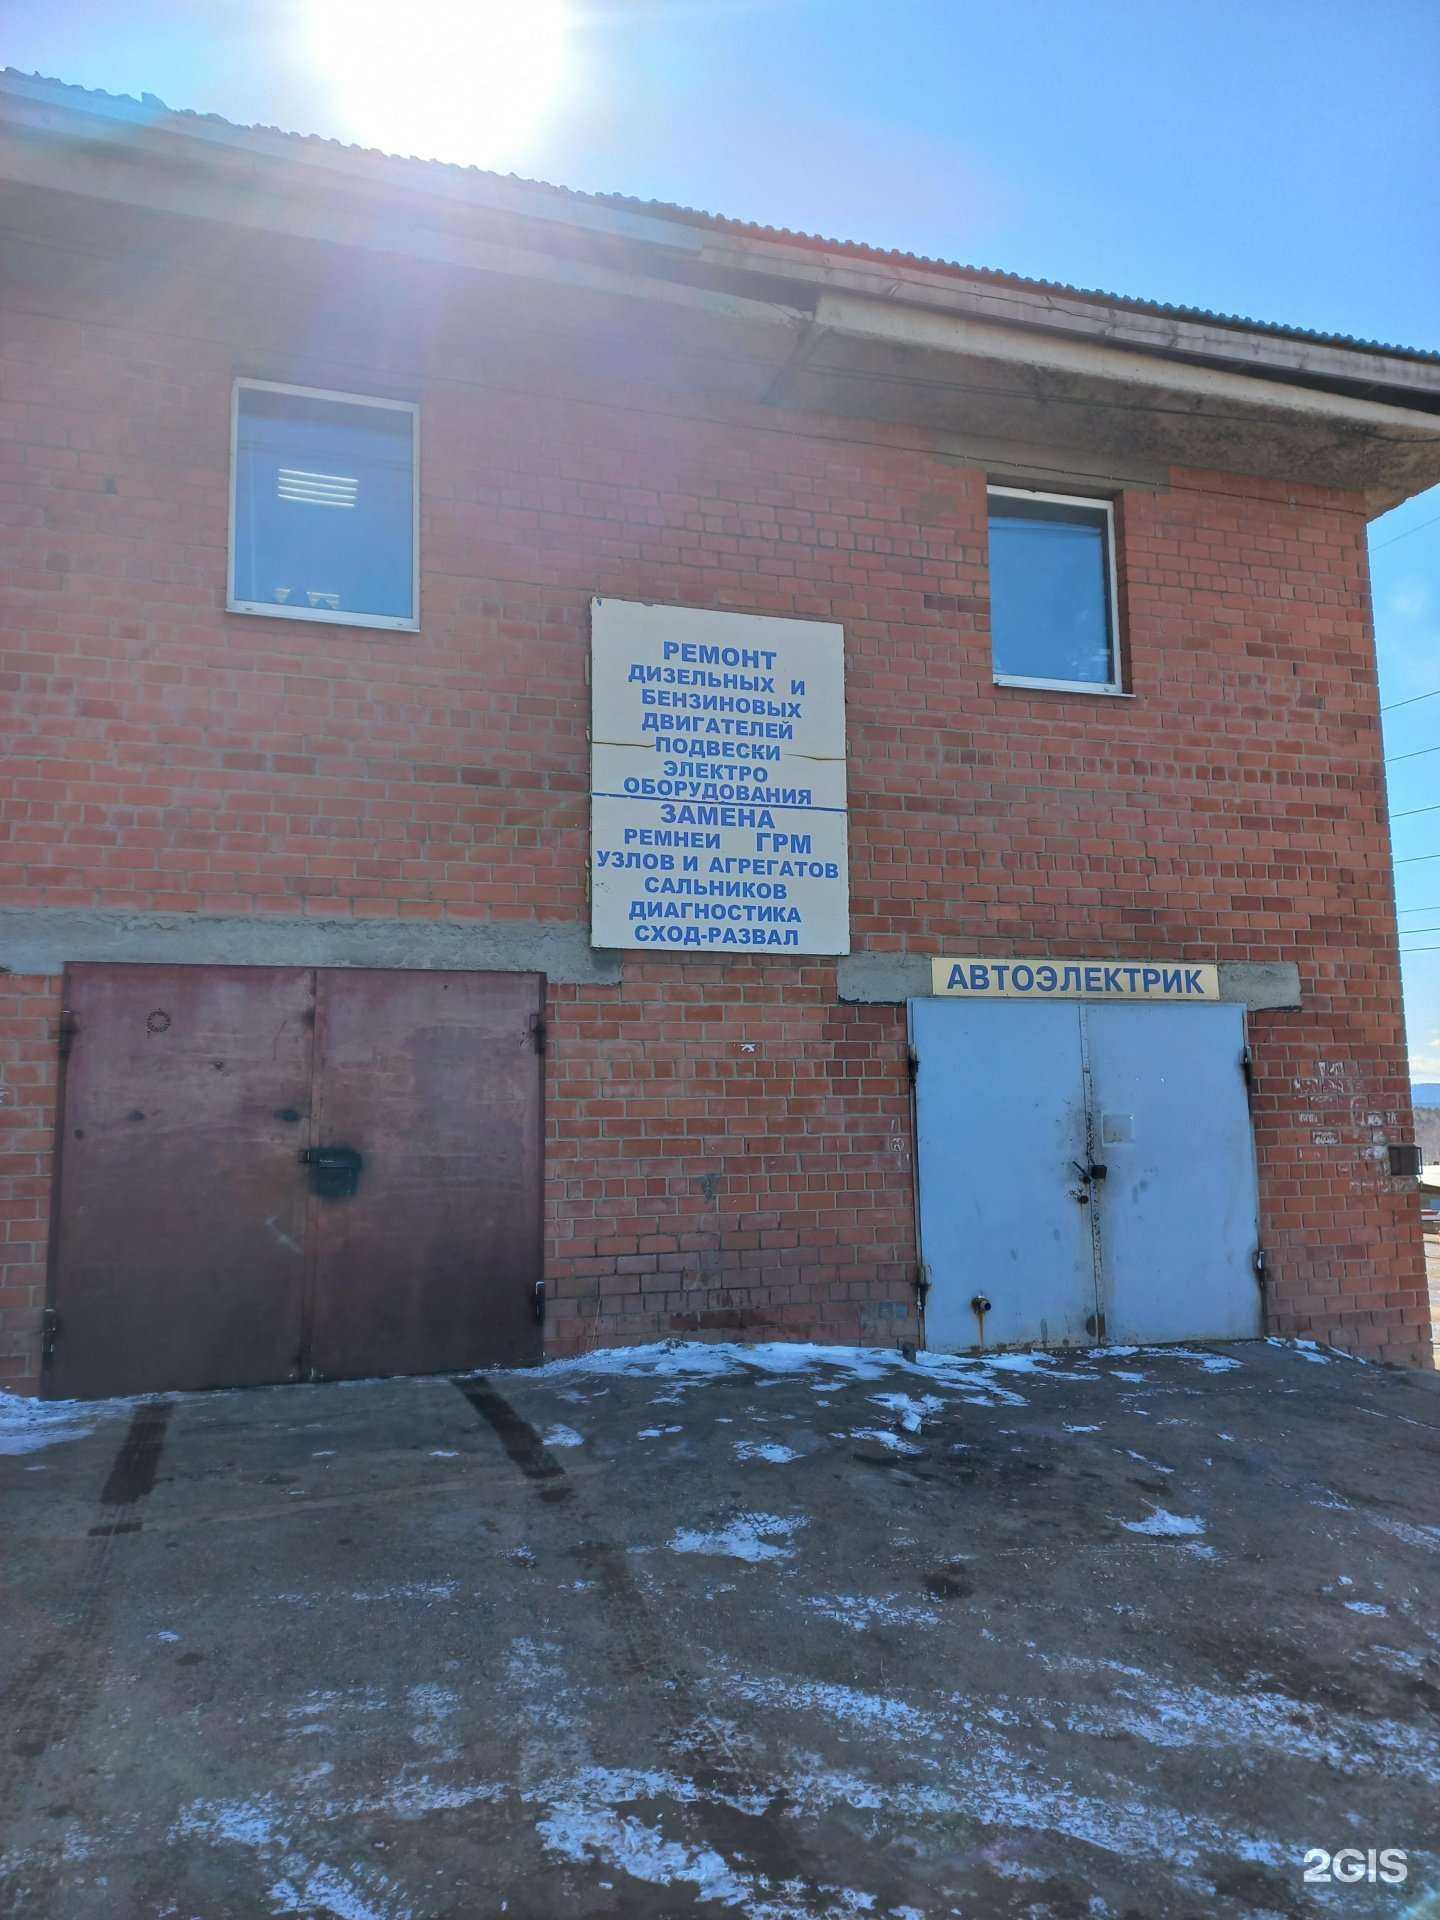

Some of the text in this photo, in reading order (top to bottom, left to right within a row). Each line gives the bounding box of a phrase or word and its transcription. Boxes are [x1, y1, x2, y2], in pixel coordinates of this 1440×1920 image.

[663, 641, 777, 670] РЕМОНТ
[628, 664, 805, 696] ДИЗЕЛЬНЫХ И
[641, 688, 802, 718] БЕНЗИНОВЫХ
[641, 712, 793, 740] ДВИГАТЕЛЕЙ
[655, 736, 780, 761] ПОДВЕСКИ
[663, 760, 768, 783] ЭЛЕКТРО
[623, 777, 812, 805] ОБОРУДОВАНИЯ
[660, 803, 775, 829] ЗАМЕНА
[756, 832, 812, 854] ГРМ
[597, 850, 839, 879] УЗЛОВ И АГРЕГАТОВ
[644, 876, 787, 900] САЛЬНИКОВ
[629, 901, 802, 923] ДИАГНОСТИКА
[634, 924, 799, 946] СХОД-РАЗВАЛ
[947, 964, 1205, 994] АВТОЭЛЕКТРИК
